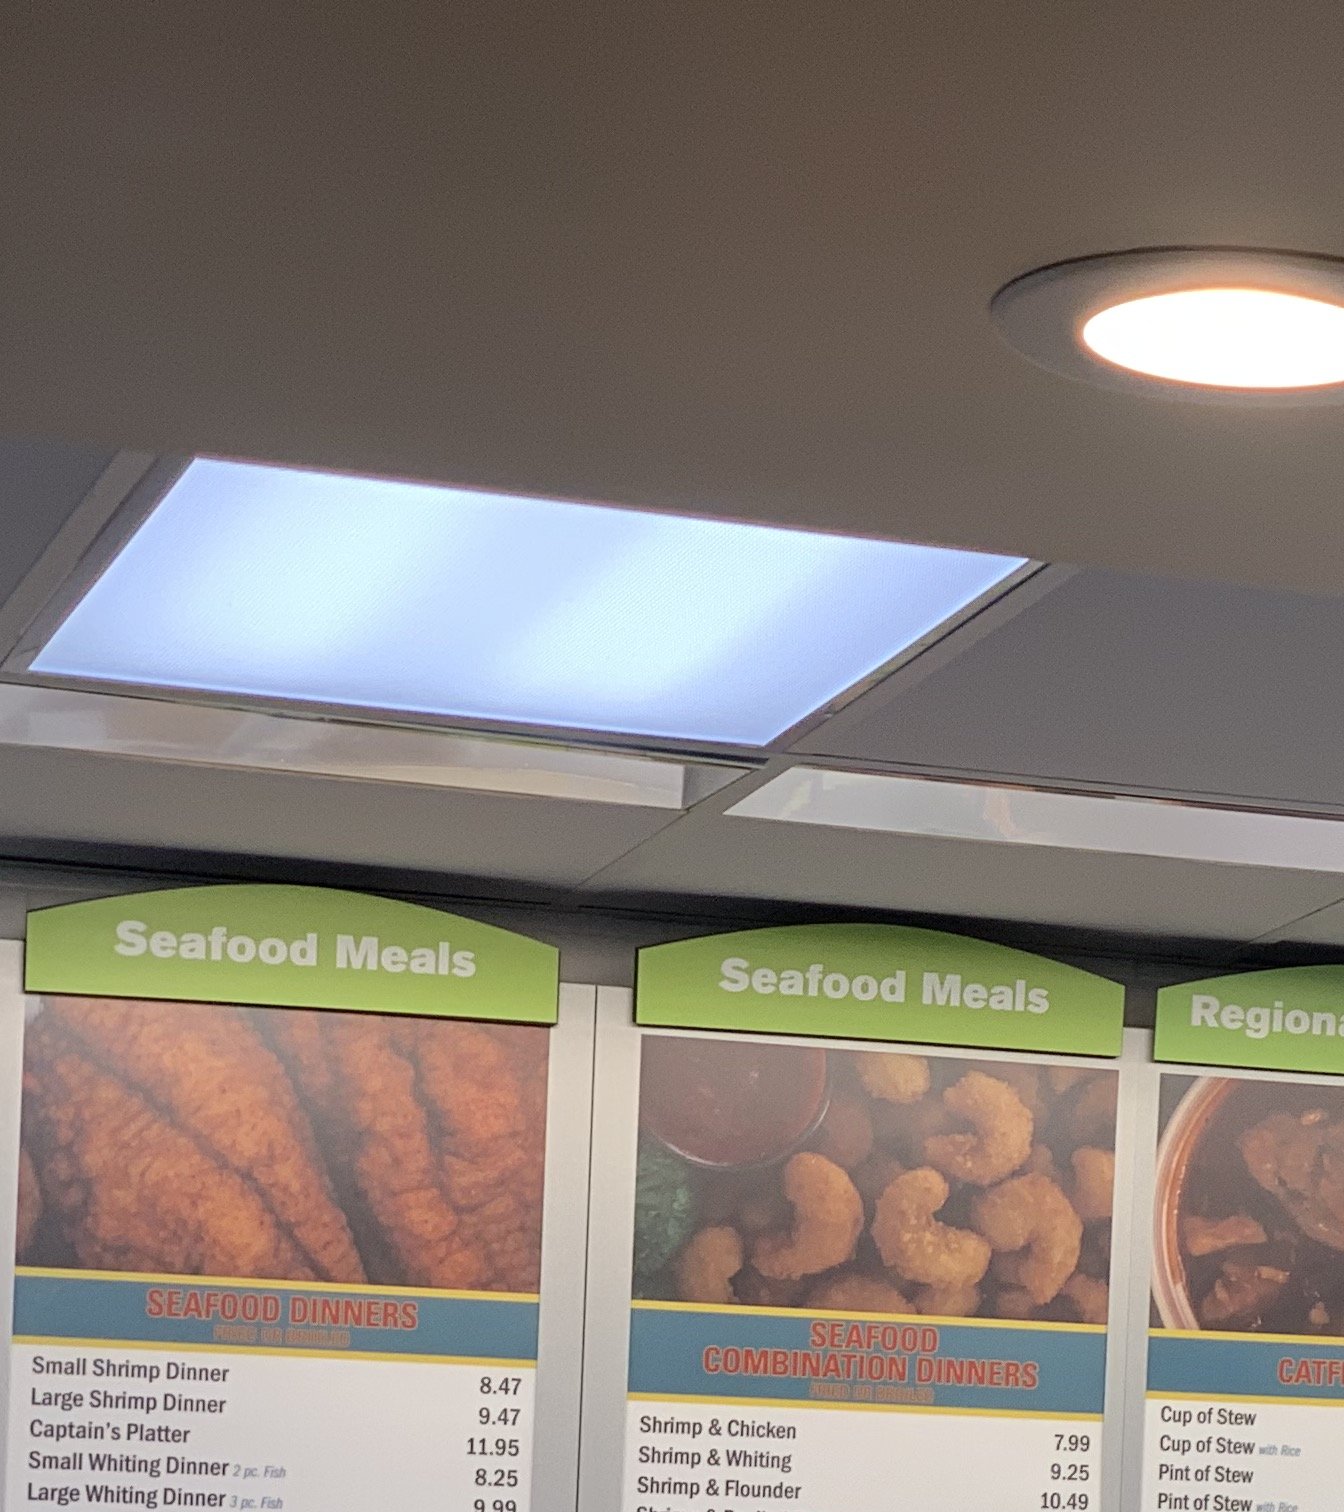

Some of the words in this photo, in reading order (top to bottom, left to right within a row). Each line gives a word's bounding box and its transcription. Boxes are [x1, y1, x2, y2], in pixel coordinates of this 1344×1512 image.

[114, 920, 317, 966] Seafood
[335, 934, 476, 977] Meals
[718, 957, 905, 1002] Seafood
[921, 972, 1049, 1014] Meals
[148, 1289, 280, 1322] SEAFOOD
[290, 1296, 416, 1329] DINNERS
[811, 1321, 937, 1353] SEAFOOD
[32, 1355, 86, 1376] Small
[92, 1358, 160, 1383] Shrimp
[166, 1361, 229, 1382] Dinner
[479, 1376, 521, 1395] 8.47
[703, 1347, 907, 1381] COMBINATION
[916, 1355, 1036, 1387] DINNERS
[1160, 1405, 1192, 1427] Cup
[1196, 1407, 1213, 1424] of
[1216, 1407, 1256, 1425] Stew
[29, 1418, 121, 1442] Captain's
[126, 1422, 190, 1443] Platter
[466, 1437, 519, 1456] 11.95
[28, 1450, 83, 1470] Small
[88, 1452, 161, 1478] Whiting
[166, 1456, 229, 1476] Dinner
[232, 1463, 241, 1477] 2
[242, 1467, 259, 1479] pc.
[263, 1465, 286, 1478] Fish
[474, 1467, 518, 1487] 8.25
[1157, 1492, 1189, 1510] Pint
[1193, 1493, 1210, 1511] of
[1212, 1494, 1252, 1512] Stew
[1255, 1501, 1275, 1512] with
